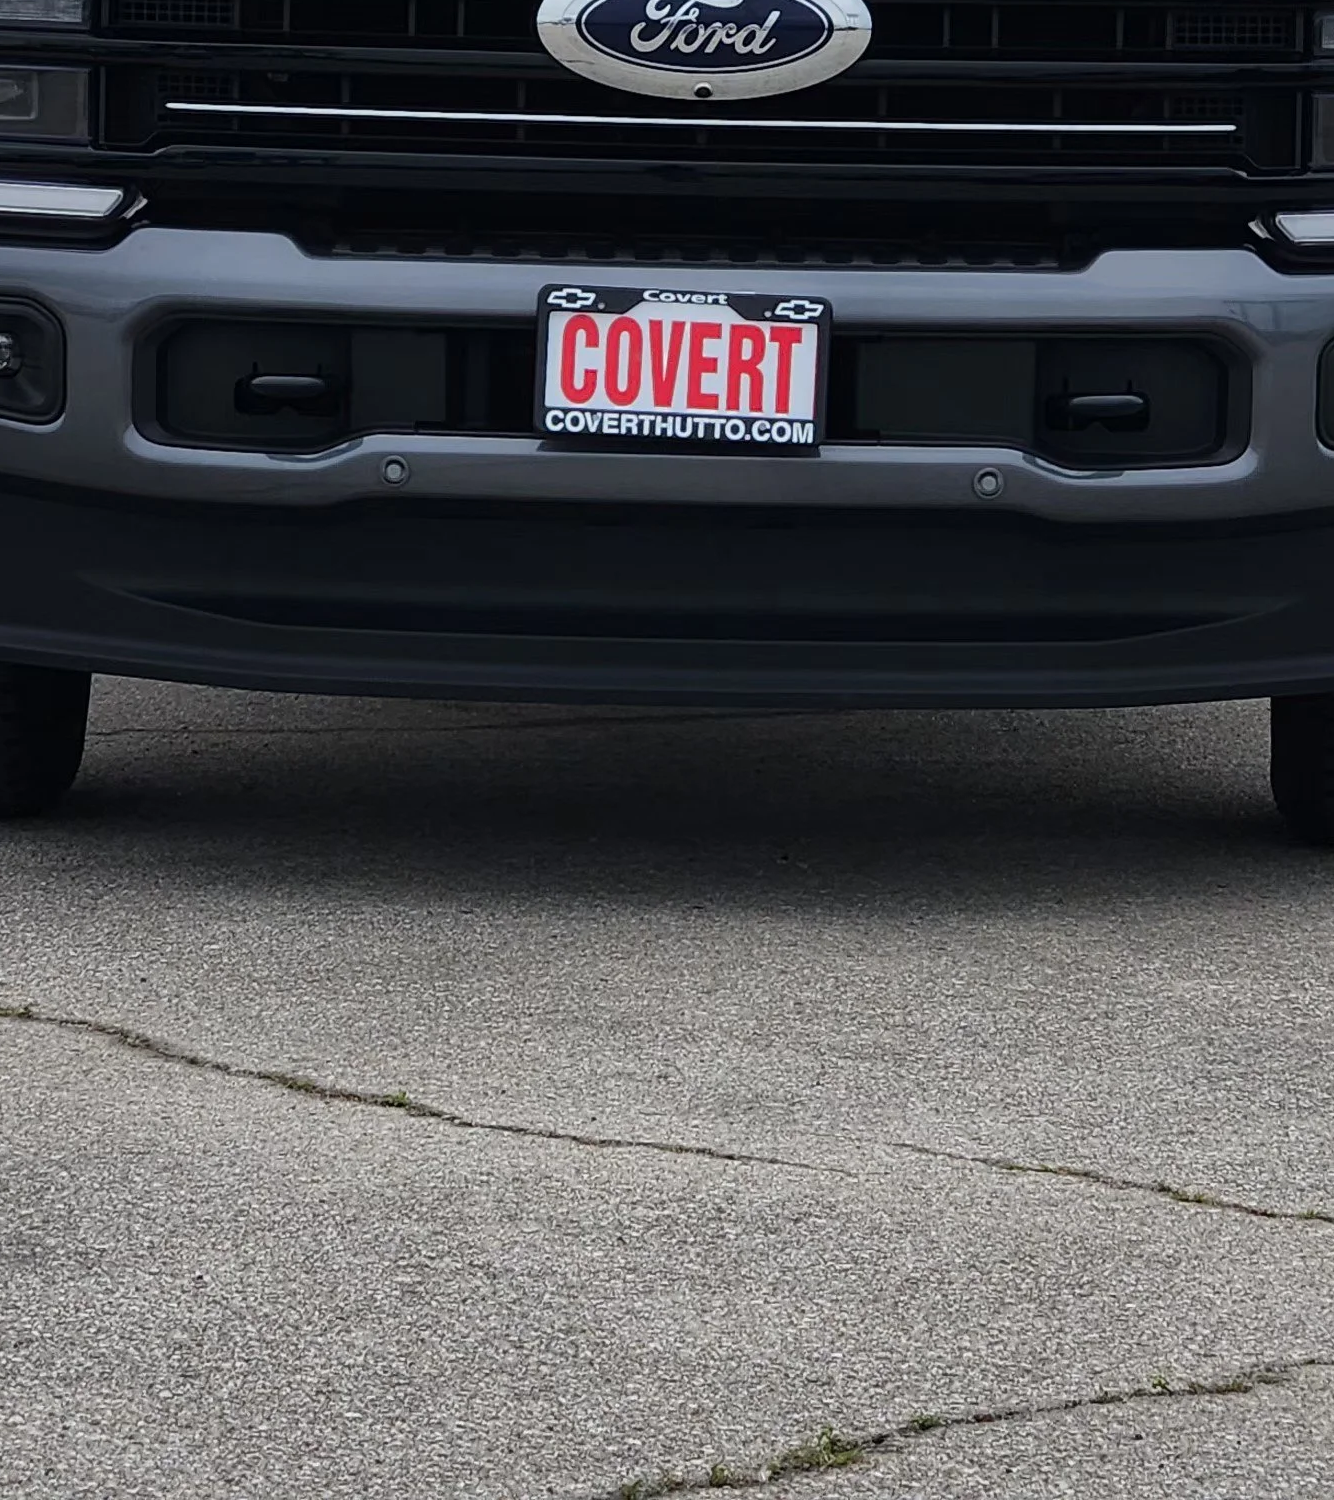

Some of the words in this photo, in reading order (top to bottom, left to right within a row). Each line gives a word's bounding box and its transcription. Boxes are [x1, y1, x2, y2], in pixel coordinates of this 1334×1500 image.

[642, 289, 728, 305] Covert
[560, 313, 803, 414] COVERT
[545, 409, 814, 444] COVERTHUTTO.COM
